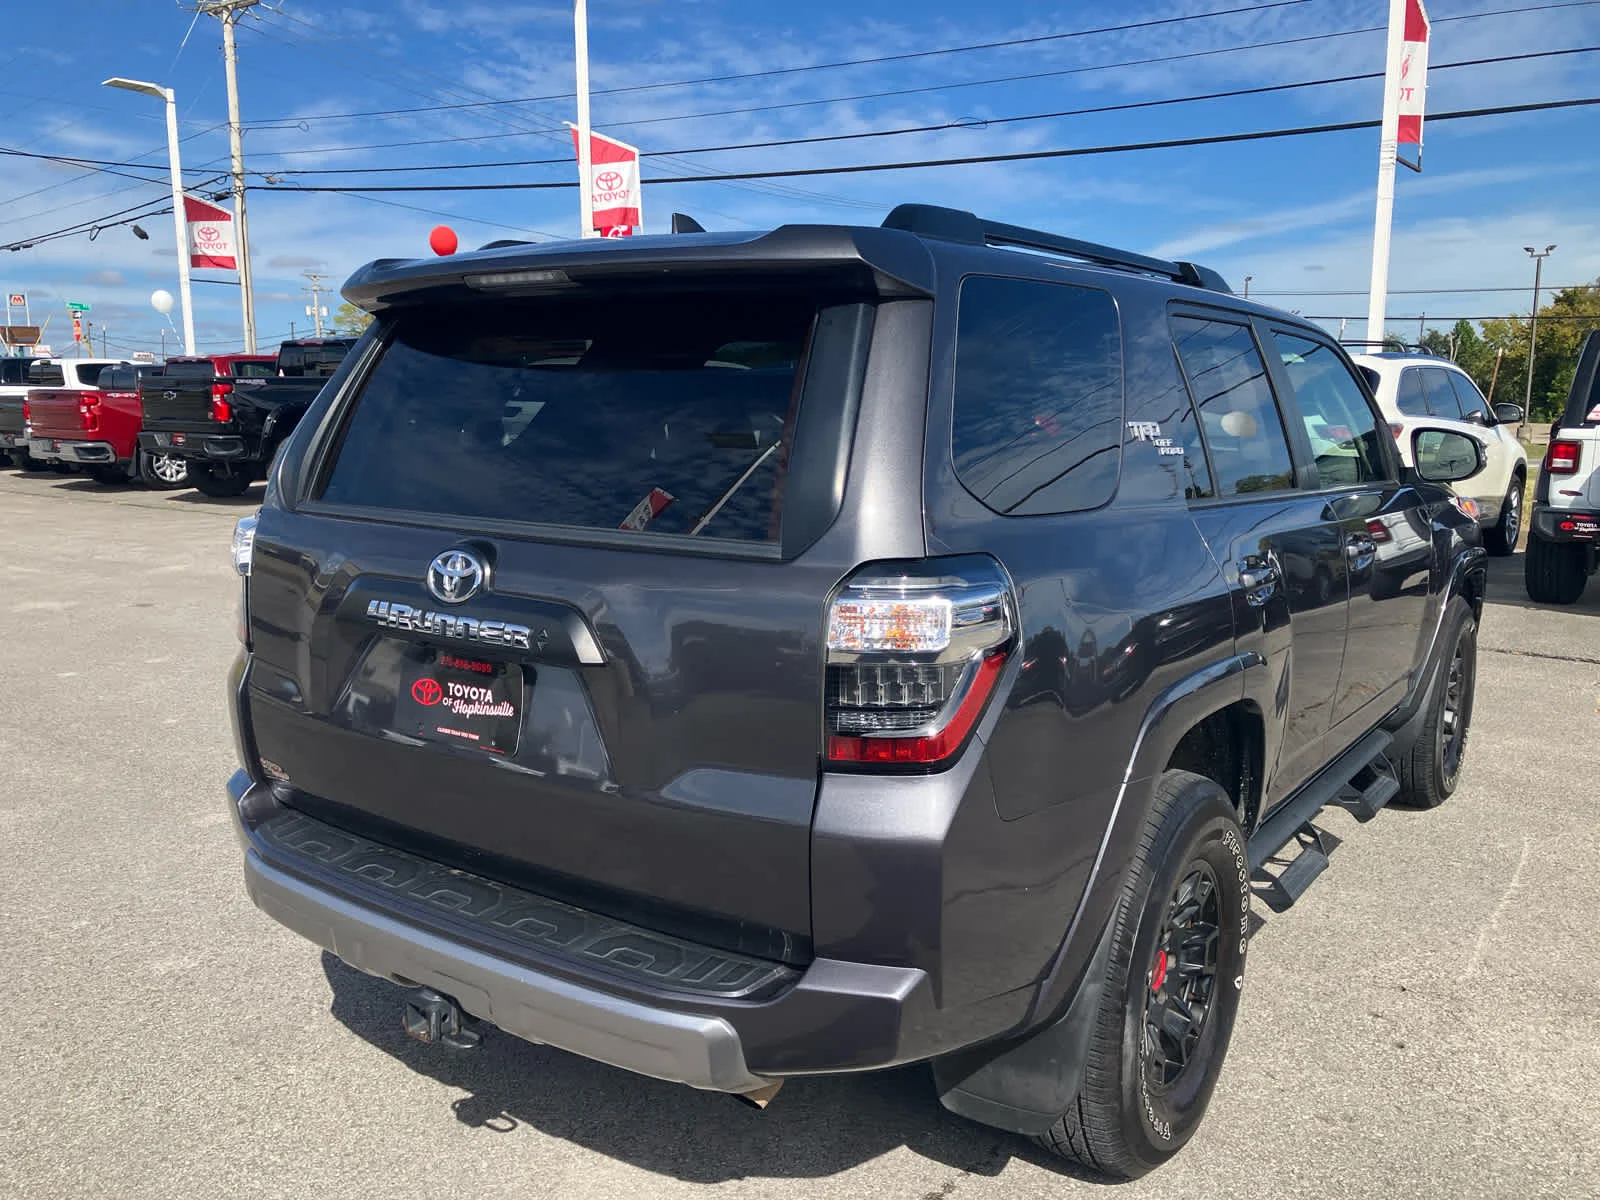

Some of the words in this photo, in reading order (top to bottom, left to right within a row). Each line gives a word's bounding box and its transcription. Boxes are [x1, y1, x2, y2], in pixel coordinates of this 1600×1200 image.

[366, 600, 530, 650] 4RUNNER
[442, 697, 453, 707] OF
[452, 701, 514, 719] Hopkinsville
[447, 682, 493, 703] TOYOTA
[1222, 830, 1249, 954] Firestone
